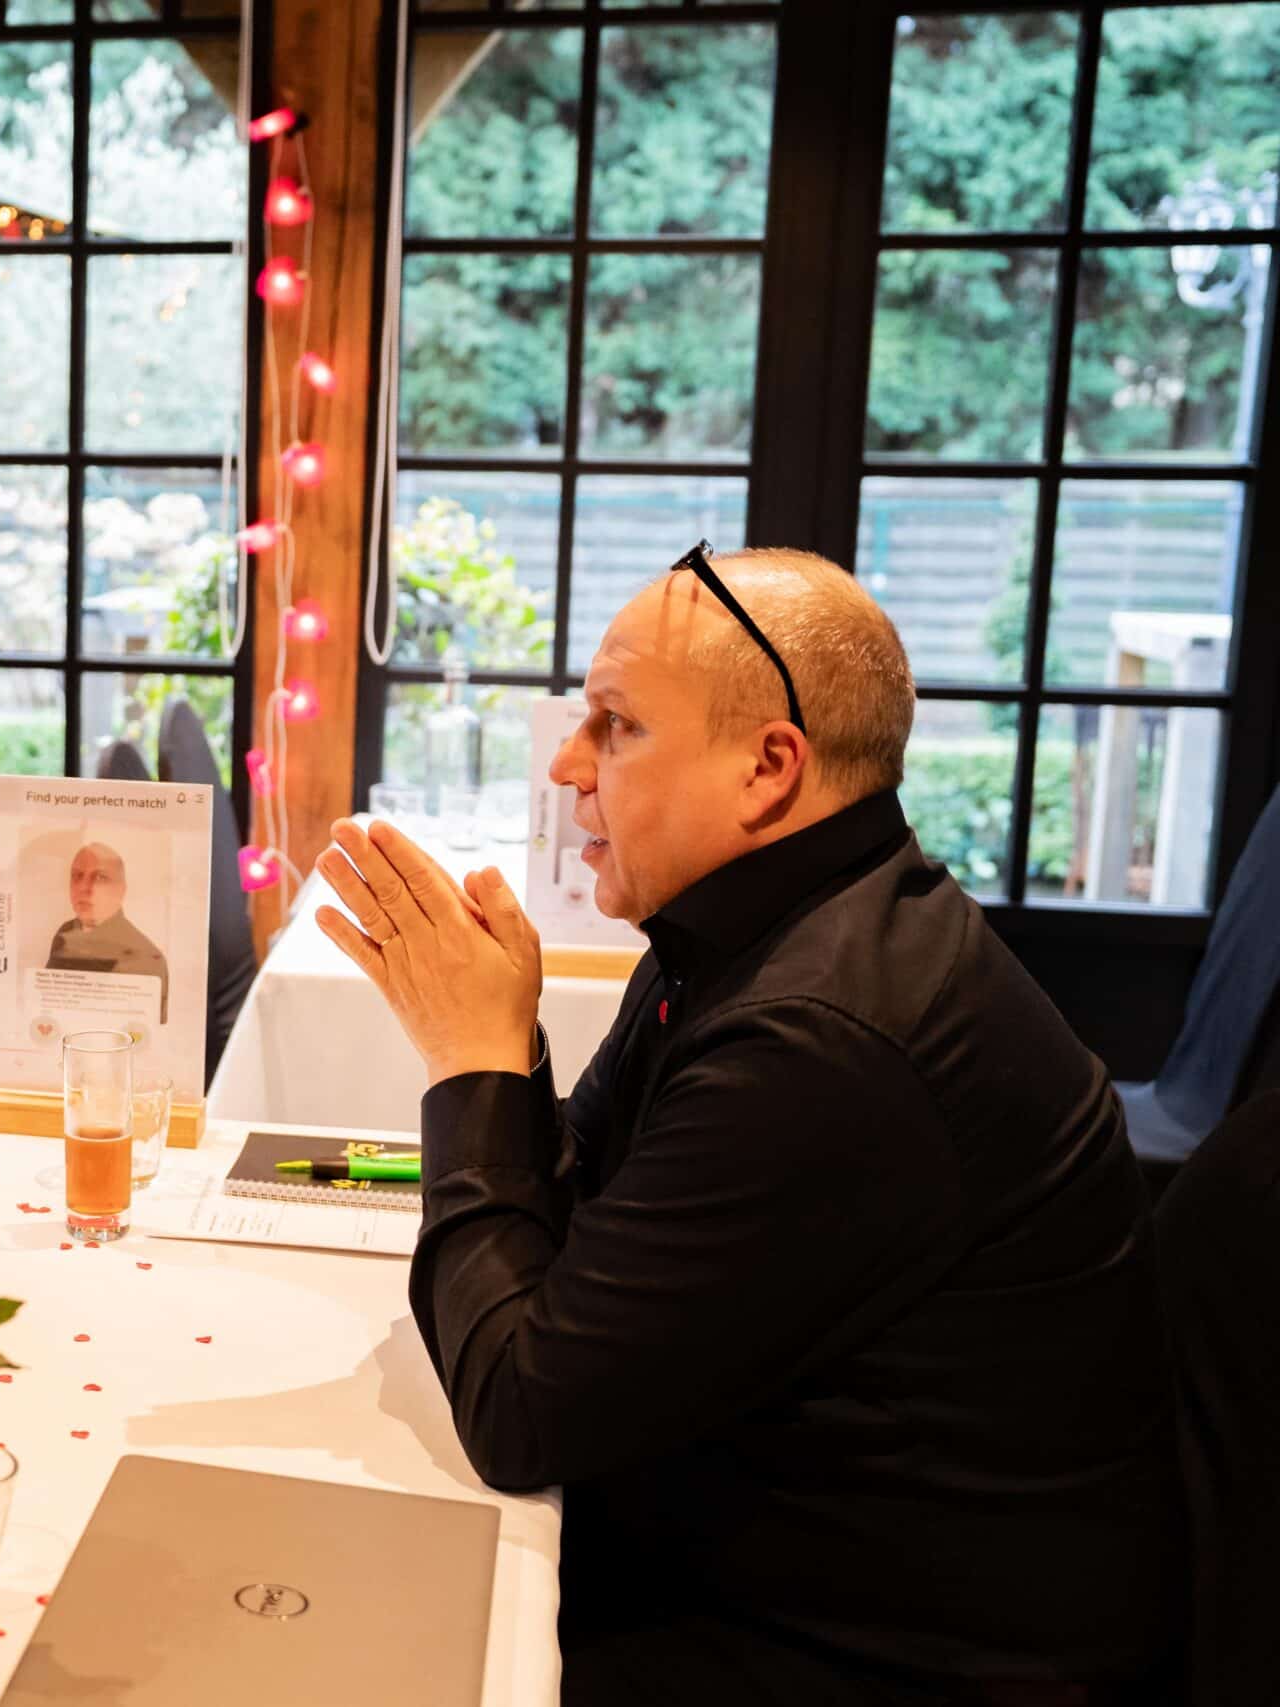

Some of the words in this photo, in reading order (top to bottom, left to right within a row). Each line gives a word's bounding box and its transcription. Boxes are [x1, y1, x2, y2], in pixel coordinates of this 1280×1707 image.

[26, 791, 51, 804] Find
[54, 793, 80, 806] your
[83, 793, 125, 808] perfect
[127, 797, 167, 810] match!
